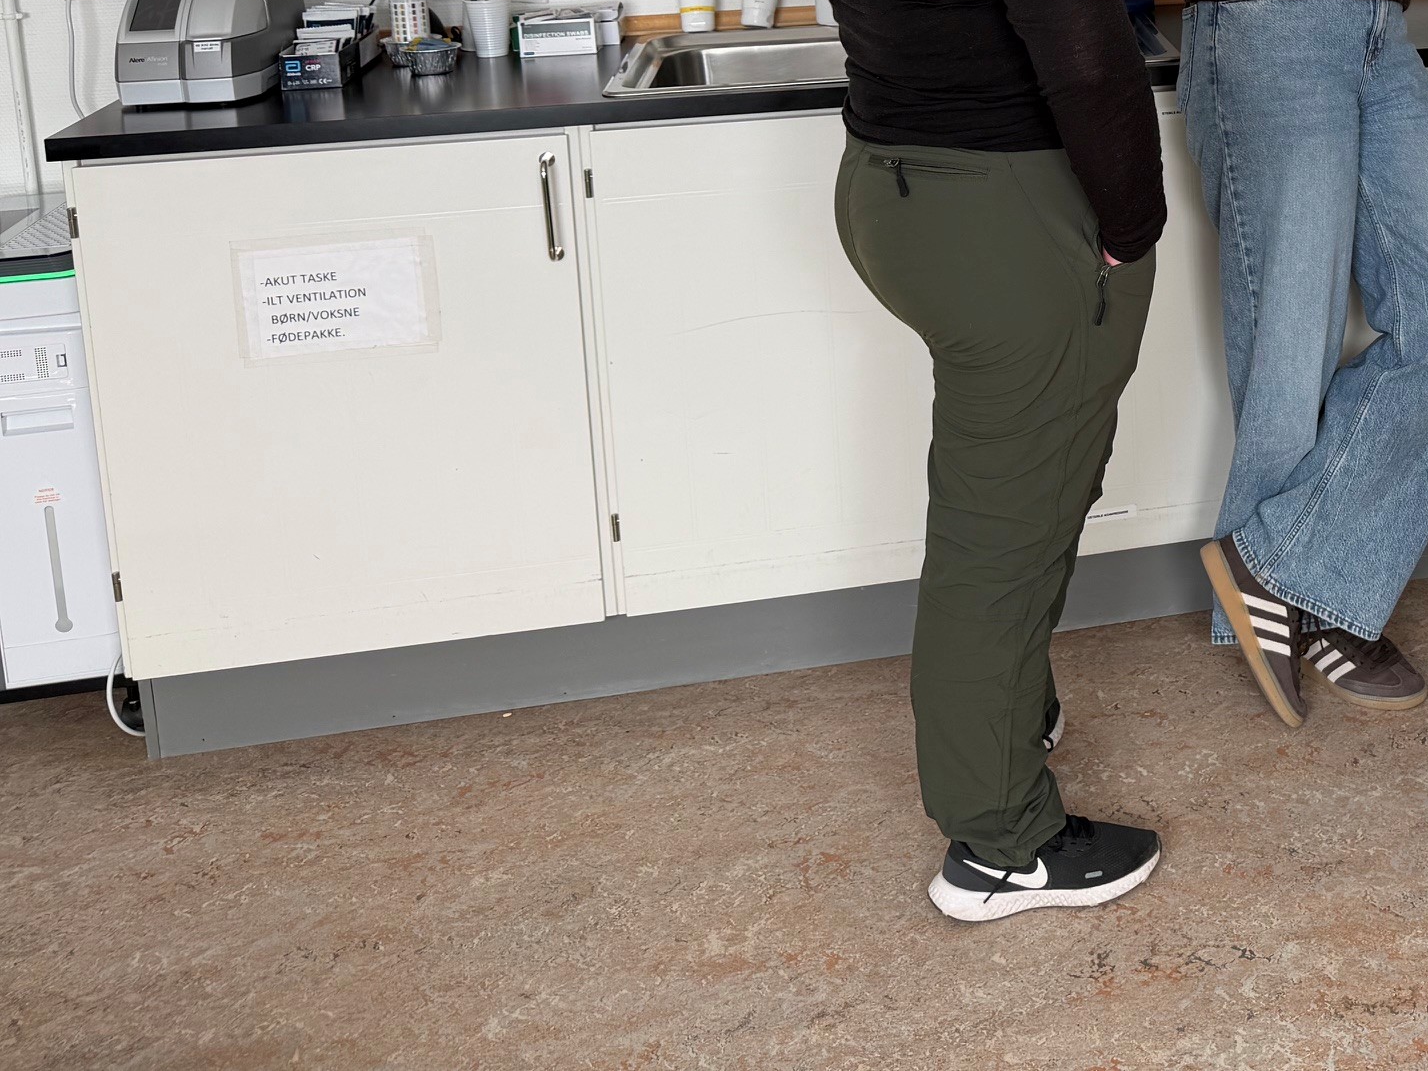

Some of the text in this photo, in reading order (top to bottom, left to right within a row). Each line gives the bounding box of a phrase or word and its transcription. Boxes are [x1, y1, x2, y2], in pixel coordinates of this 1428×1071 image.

[524, 31, 565, 39] DISINFECTION
[260, 271, 337, 287] -AKUT TASKE
[262, 287, 366, 306] -ILT VENTILATION
[271, 307, 360, 325] BØRN/VOKSNE
[267, 327, 345, 344] -FØDEPAKKE.
